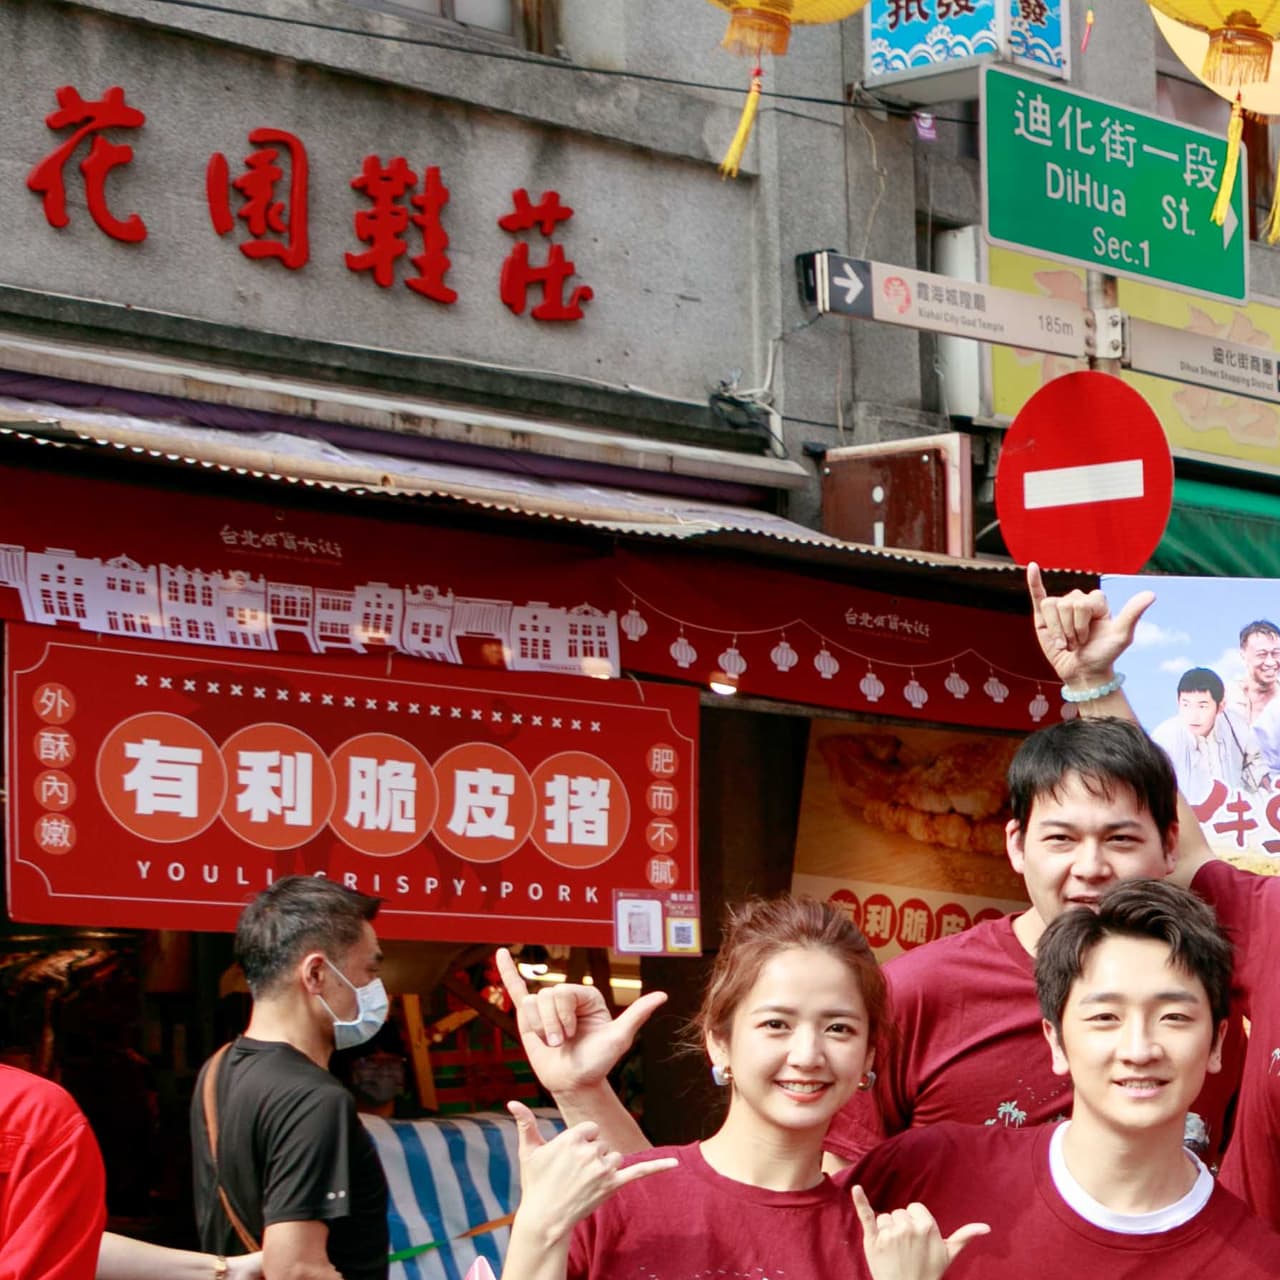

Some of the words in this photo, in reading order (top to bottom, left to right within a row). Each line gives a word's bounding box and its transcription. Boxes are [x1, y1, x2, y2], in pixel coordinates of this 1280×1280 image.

[1012, 89, 1218, 194] 迪化街一段
[1044, 160, 1128, 219] DiHua
[1161, 195, 1197, 237] St.
[1093, 226, 1152, 269] Sec.1
[1037, 314, 1074, 337] 185m
